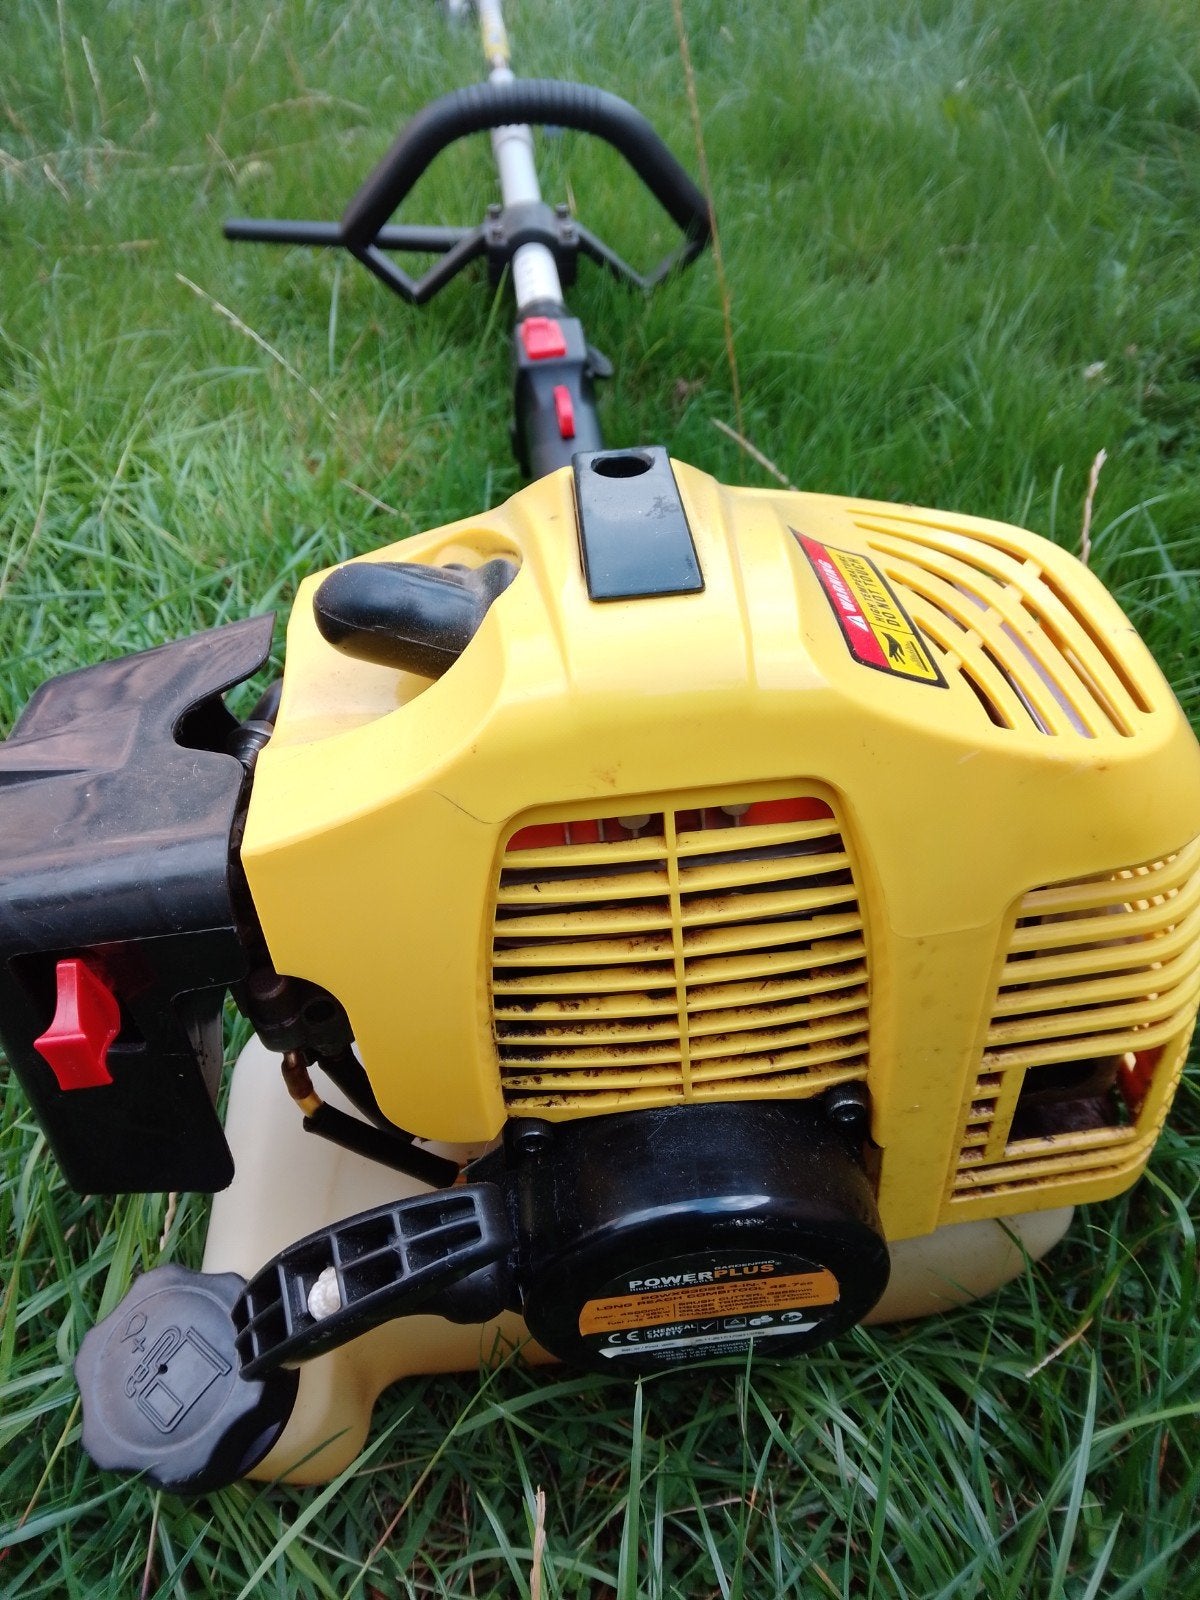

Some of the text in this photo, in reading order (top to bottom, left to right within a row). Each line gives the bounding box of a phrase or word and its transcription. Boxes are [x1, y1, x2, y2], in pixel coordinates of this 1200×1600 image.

[817, 559, 857, 612] WARNING
[838, 554, 887, 624] HIGH TEMPERATURE
[848, 556, 901, 628] DO NOT TOUCH
[629, 1264, 775, 1288] POWERPLUS
[595, 1302, 634, 1312] LONG
[637, 1296, 683, 1307] REACH
[687, 1287, 765, 1301] COMBITOOL
[678, 1298, 716, 1306] BRUSH
[678, 1302, 715, 1310] HEDGE
[607, 1330, 641, 1344] CE
[646, 1324, 697, 1335] CHEMICAL
[647, 1329, 684, 1339] SAFETY
